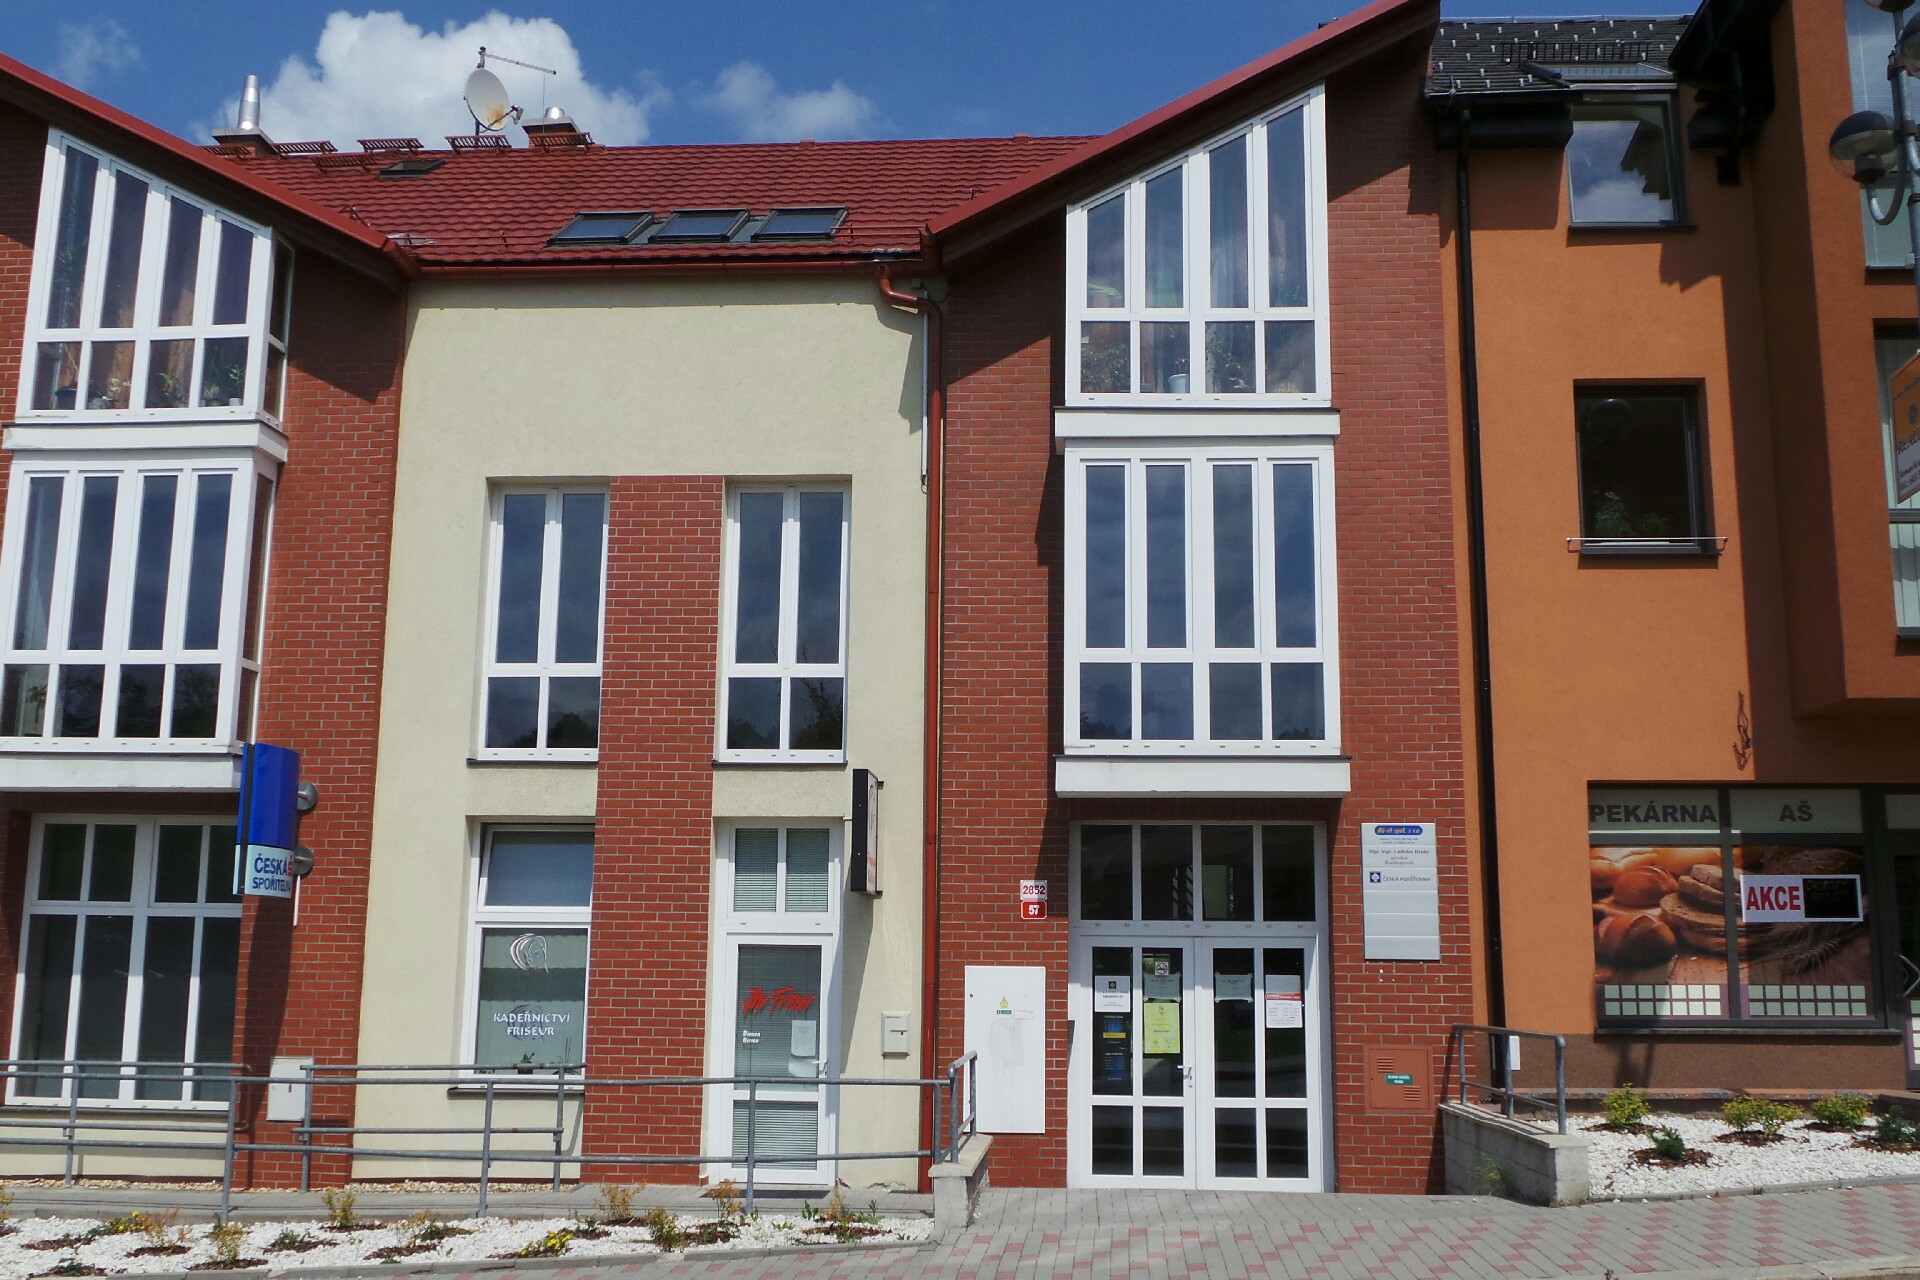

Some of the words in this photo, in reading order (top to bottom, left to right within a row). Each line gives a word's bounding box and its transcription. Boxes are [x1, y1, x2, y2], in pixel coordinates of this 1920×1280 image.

[1588, 800, 1717, 823] PEKÁRNA
[1778, 800, 1814, 822] AŠ
[254, 853, 287, 876] ČESKÁ
[1023, 885, 1045, 894] 2852
[1746, 885, 1802, 911] AKCE
[1028, 904, 1039, 915] 57
[493, 1011, 571, 1023] KADEŘNICTVÍ
[507, 1026, 555, 1036] FRISEUR
